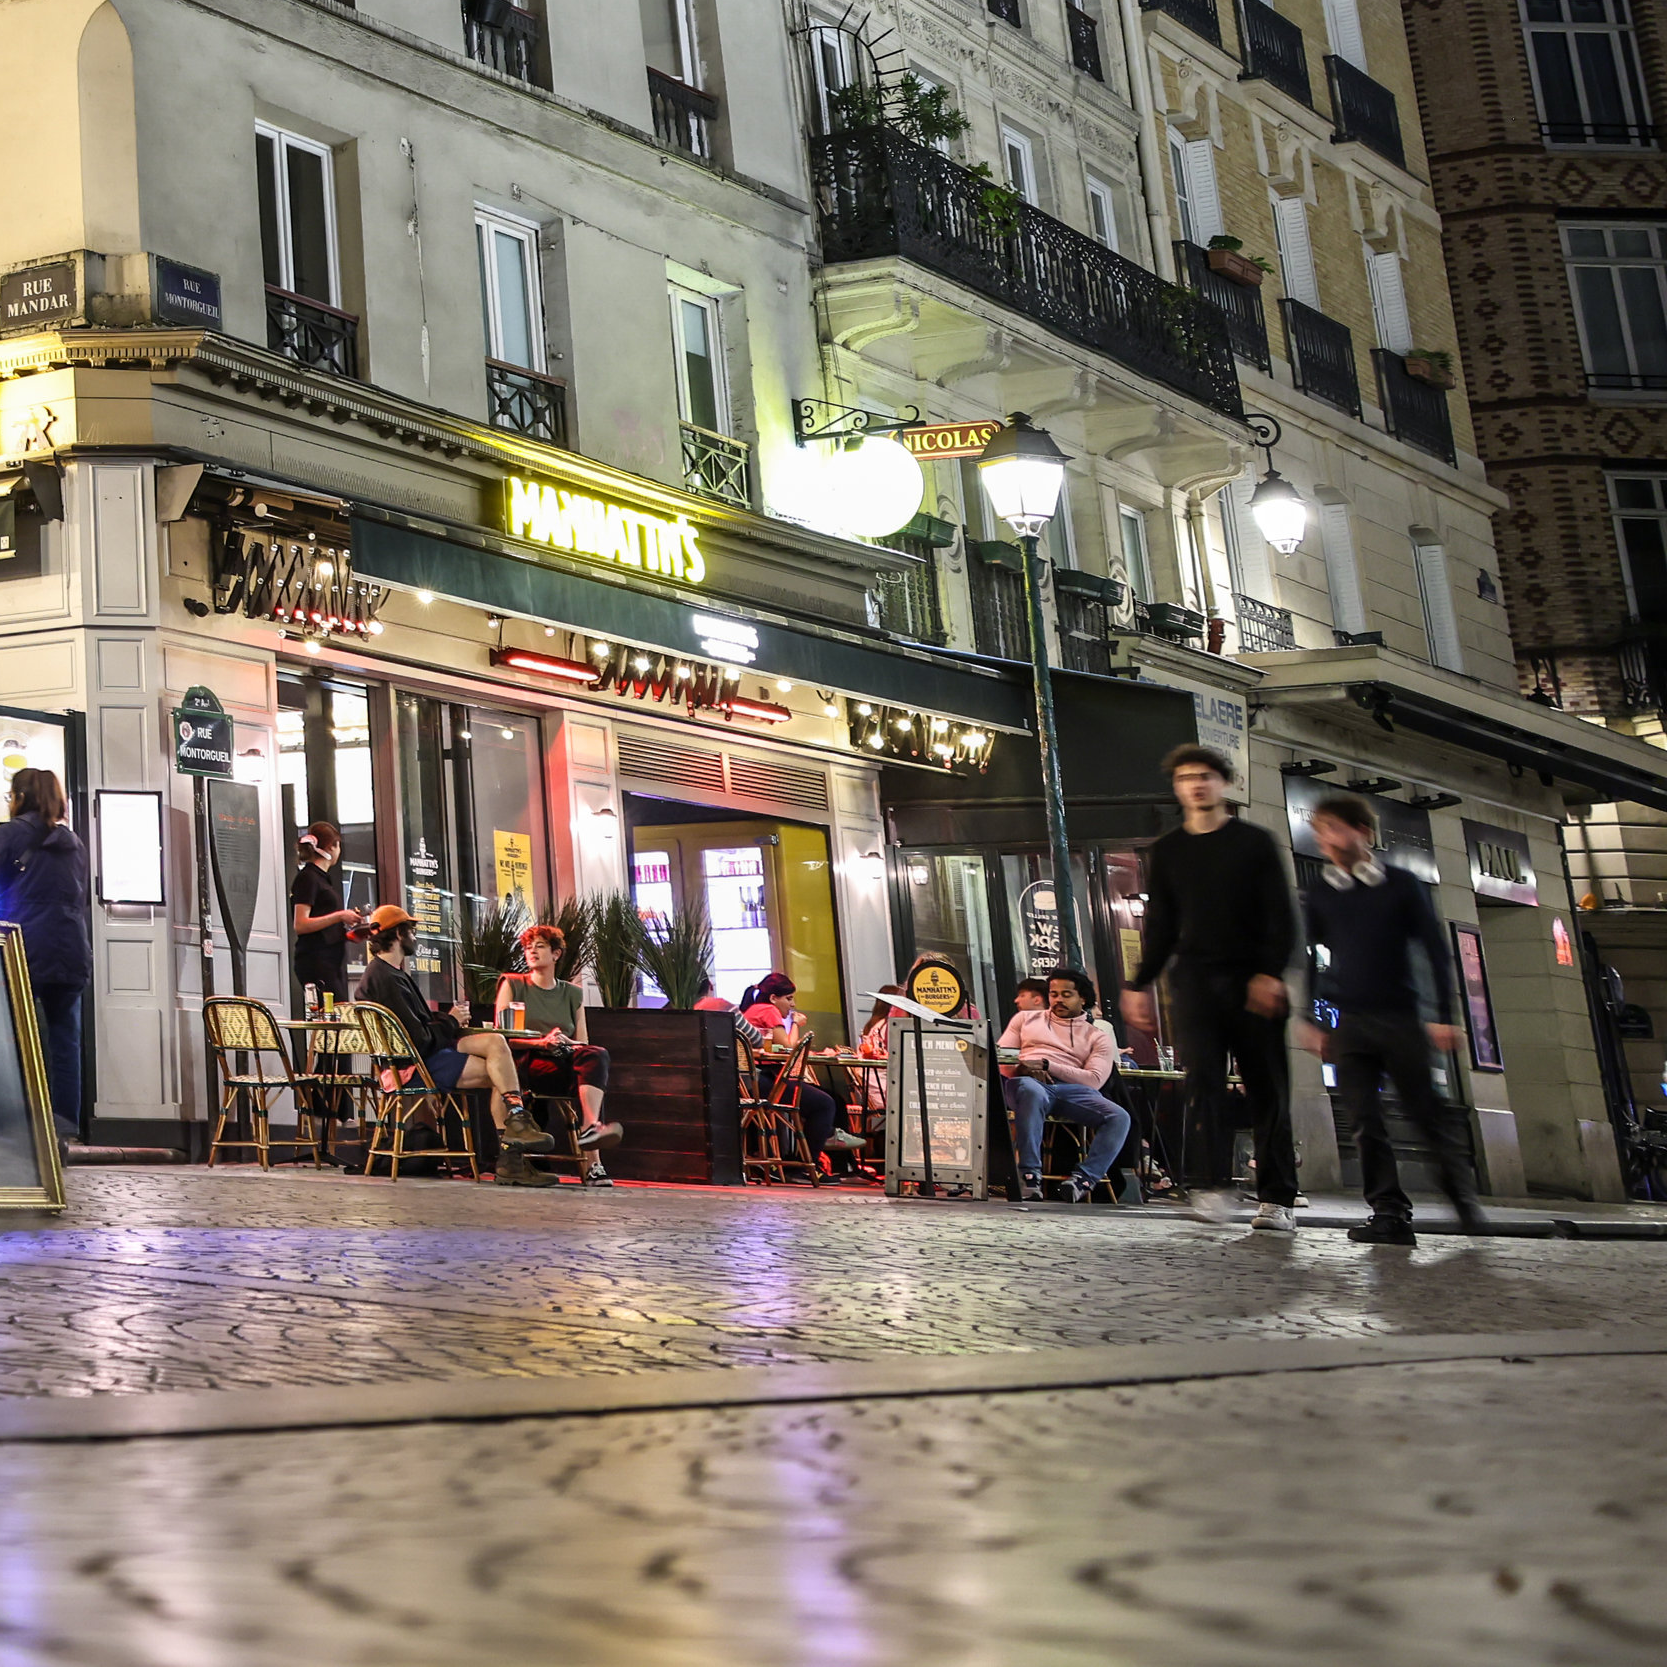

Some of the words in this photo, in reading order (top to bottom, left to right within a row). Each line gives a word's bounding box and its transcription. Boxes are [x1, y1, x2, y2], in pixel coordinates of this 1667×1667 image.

[22, 277, 53, 297] RUE
[182, 277, 202, 295] RUE
[165, 290, 220, 319] MONTORGUEIL
[902, 428, 992, 451] NICOLAS
[1193, 692, 1243, 730] ELAERE
[197, 727, 213, 740] RUE
[1199, 725, 1240, 750] OUVERTURE
[179, 744, 231, 763] MONTORGUEIL
[1476, 840, 1528, 884] PAUL
[430, 959, 441, 973] OUT
[911, 1040, 933, 1049] LNCH
[935, 1040, 955, 1050] MENU
